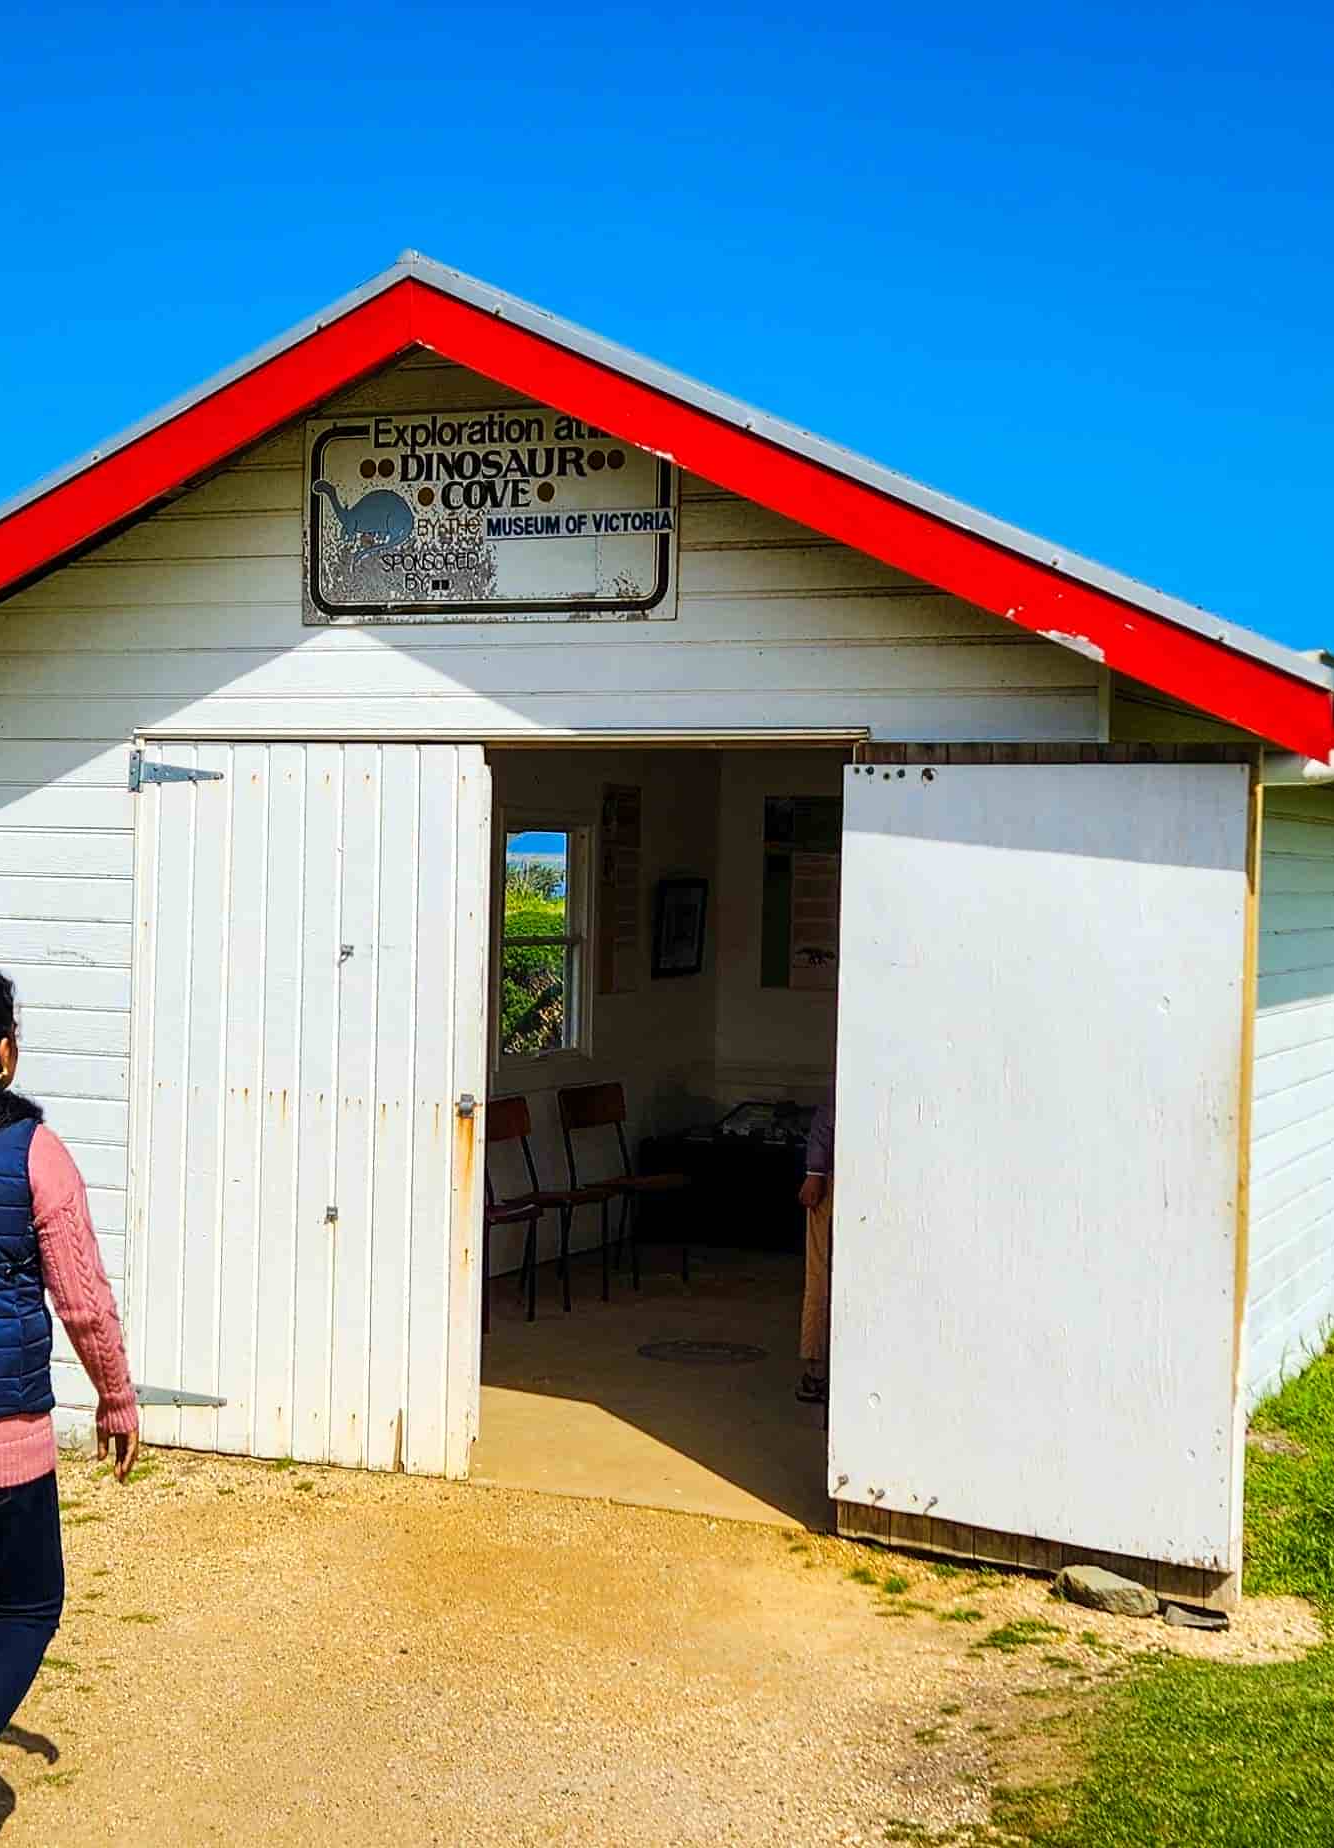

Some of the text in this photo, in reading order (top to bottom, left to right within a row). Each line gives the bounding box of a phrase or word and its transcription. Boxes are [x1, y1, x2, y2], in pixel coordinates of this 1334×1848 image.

[373, 411, 545, 453] Exploration
[400, 447, 588, 482] DINOSAUR
[441, 478, 532, 509] COVE
[417, 518, 440, 537] BY
[486, 516, 560, 537] MUSEUM
[565, 514, 588, 535] OF
[592, 511, 673, 533] VICTORIA
